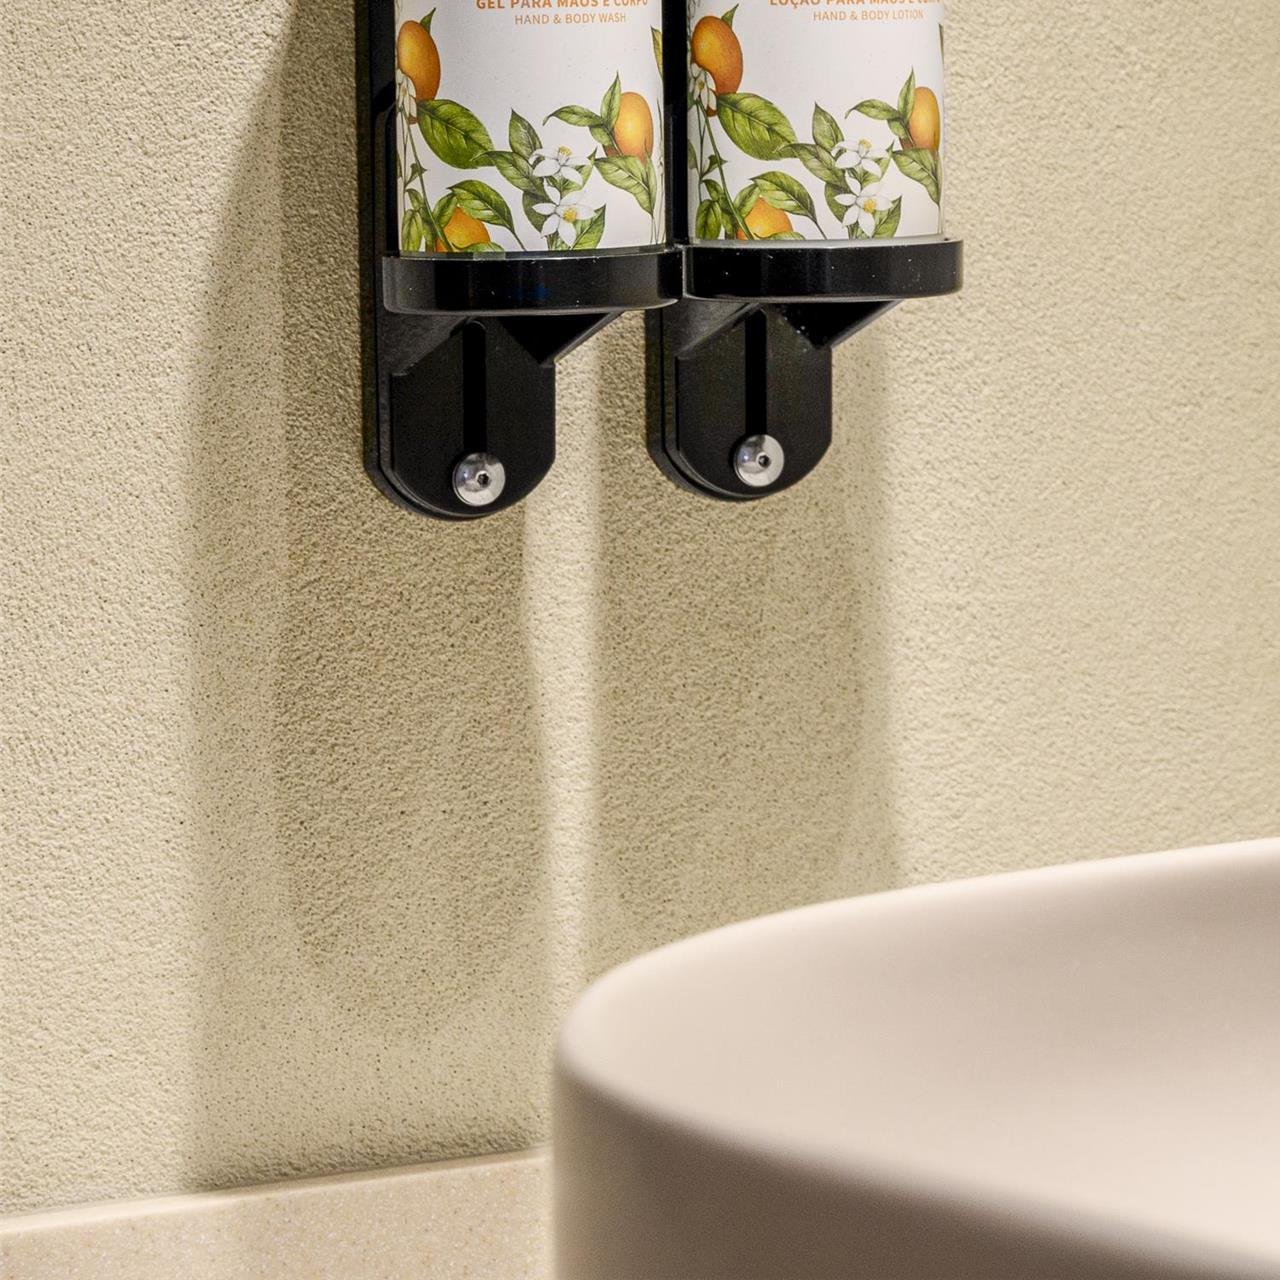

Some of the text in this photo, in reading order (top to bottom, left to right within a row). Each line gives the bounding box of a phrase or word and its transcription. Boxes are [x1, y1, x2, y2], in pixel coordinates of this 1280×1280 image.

[515, 12, 626, 24] HAND & BODY WASH
[813, 9, 923, 21] HAND & BODY LOTION
